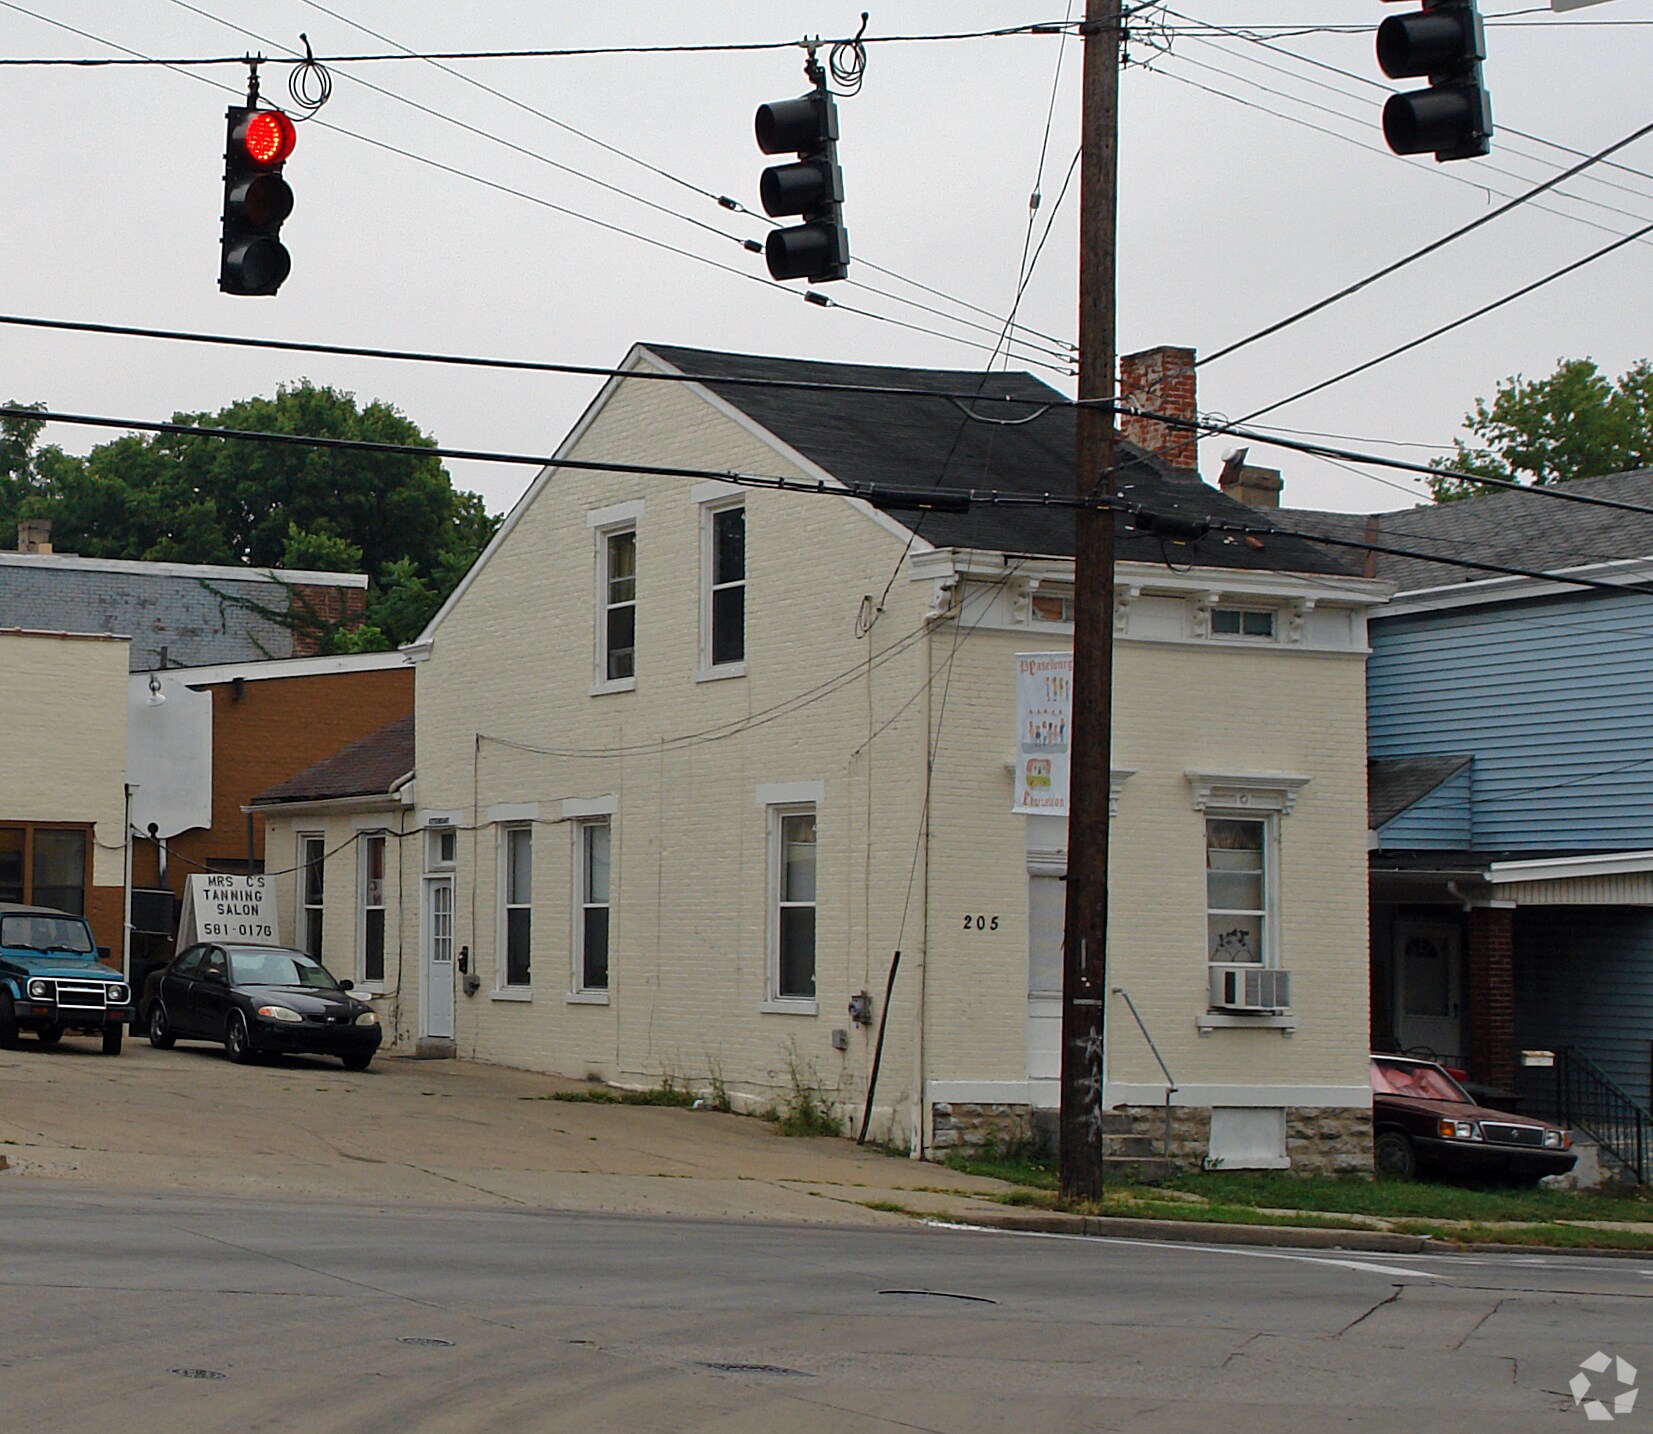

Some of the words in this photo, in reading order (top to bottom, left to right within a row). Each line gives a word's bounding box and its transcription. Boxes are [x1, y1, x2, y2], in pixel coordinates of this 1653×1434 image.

[208, 875, 234, 887] MRS
[203, 889, 263, 902] TANNING
[217, 903, 259, 916] SALON
[963, 914, 999, 931] 205
